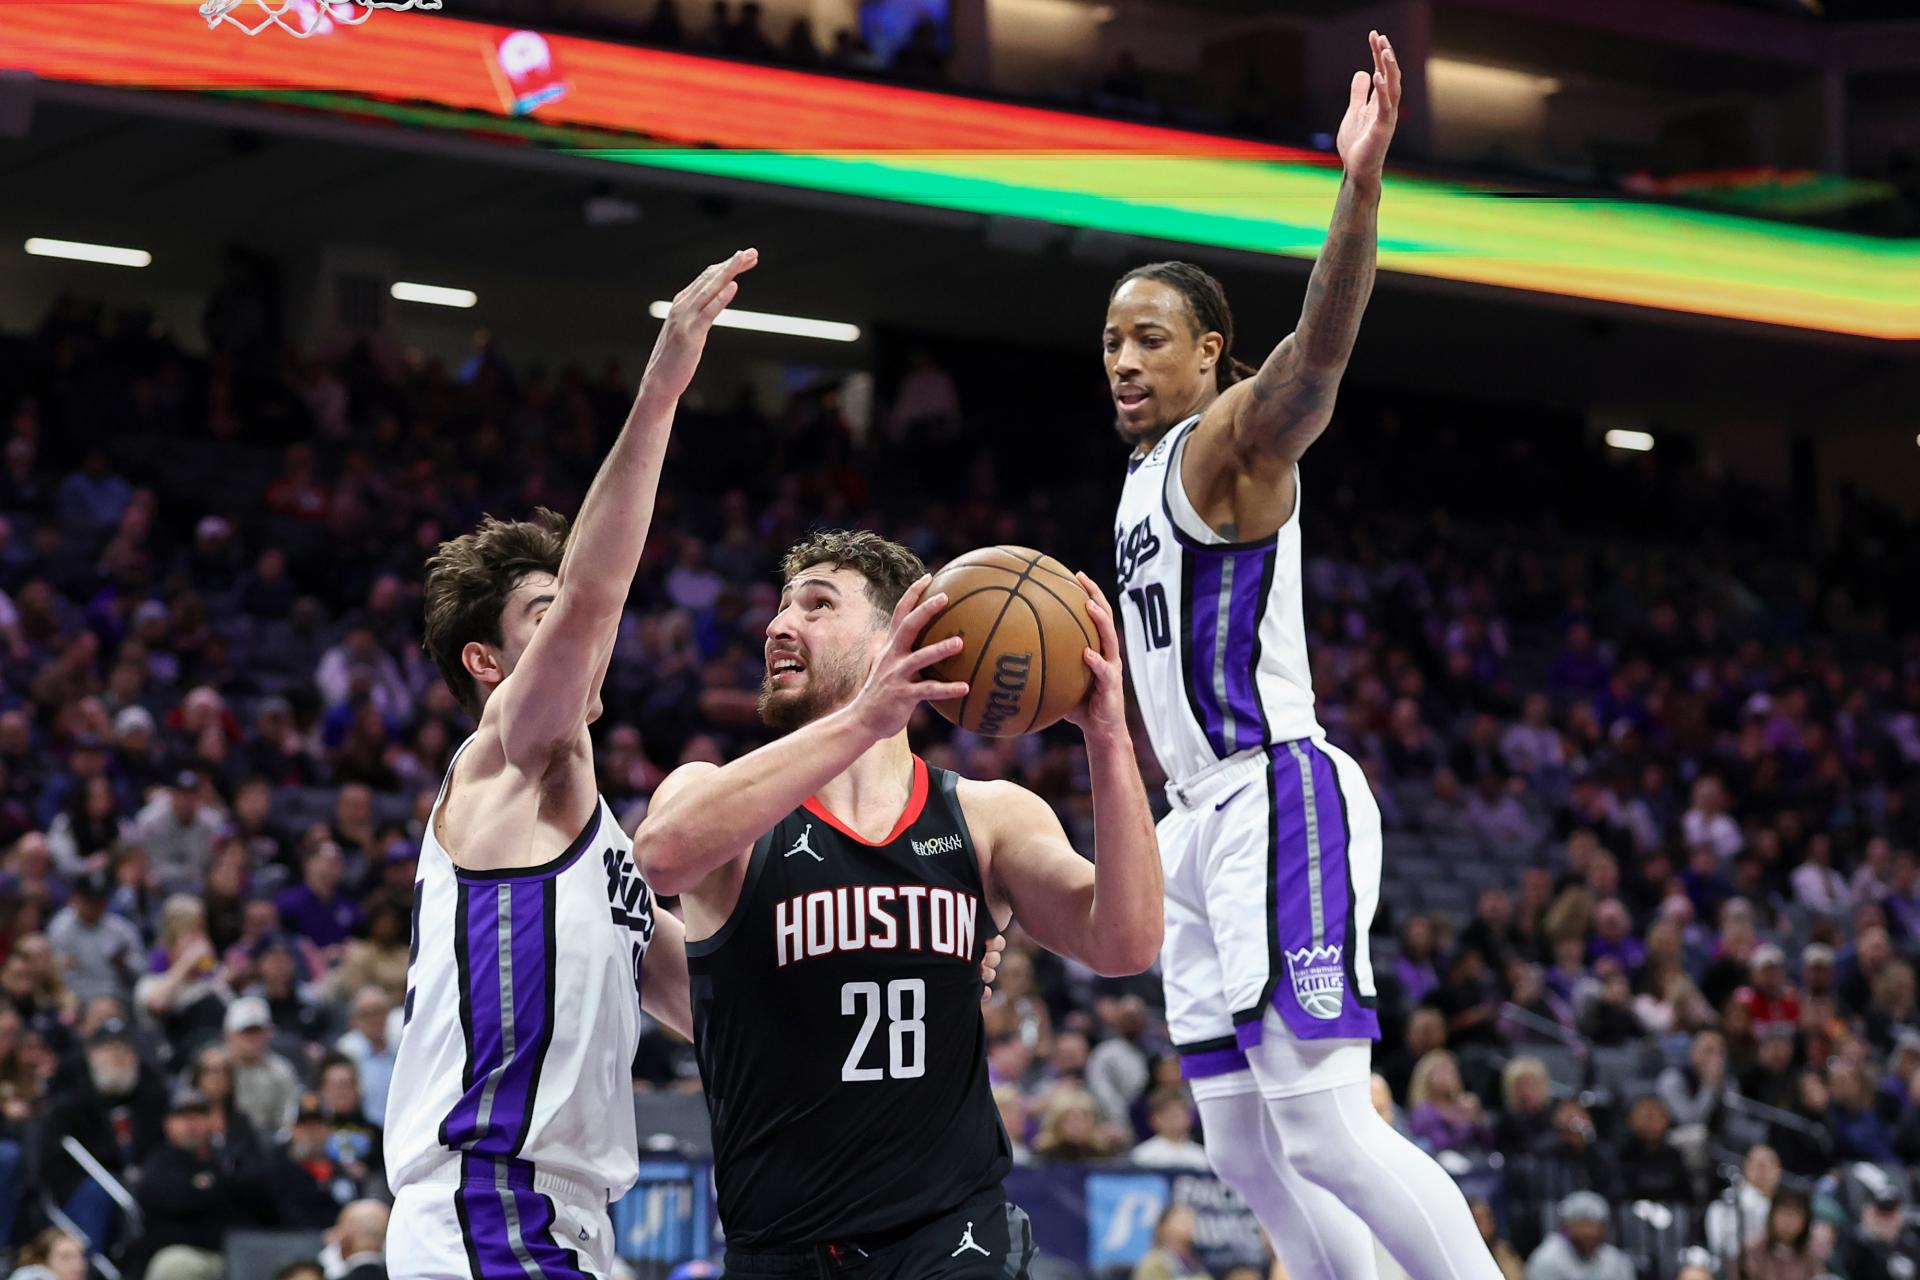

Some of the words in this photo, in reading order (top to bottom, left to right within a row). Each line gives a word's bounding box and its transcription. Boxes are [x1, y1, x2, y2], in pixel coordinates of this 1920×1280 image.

[1127, 582, 1172, 653] 10
[775, 884, 979, 970] HOUSTON
[840, 977, 926, 1082] 28
